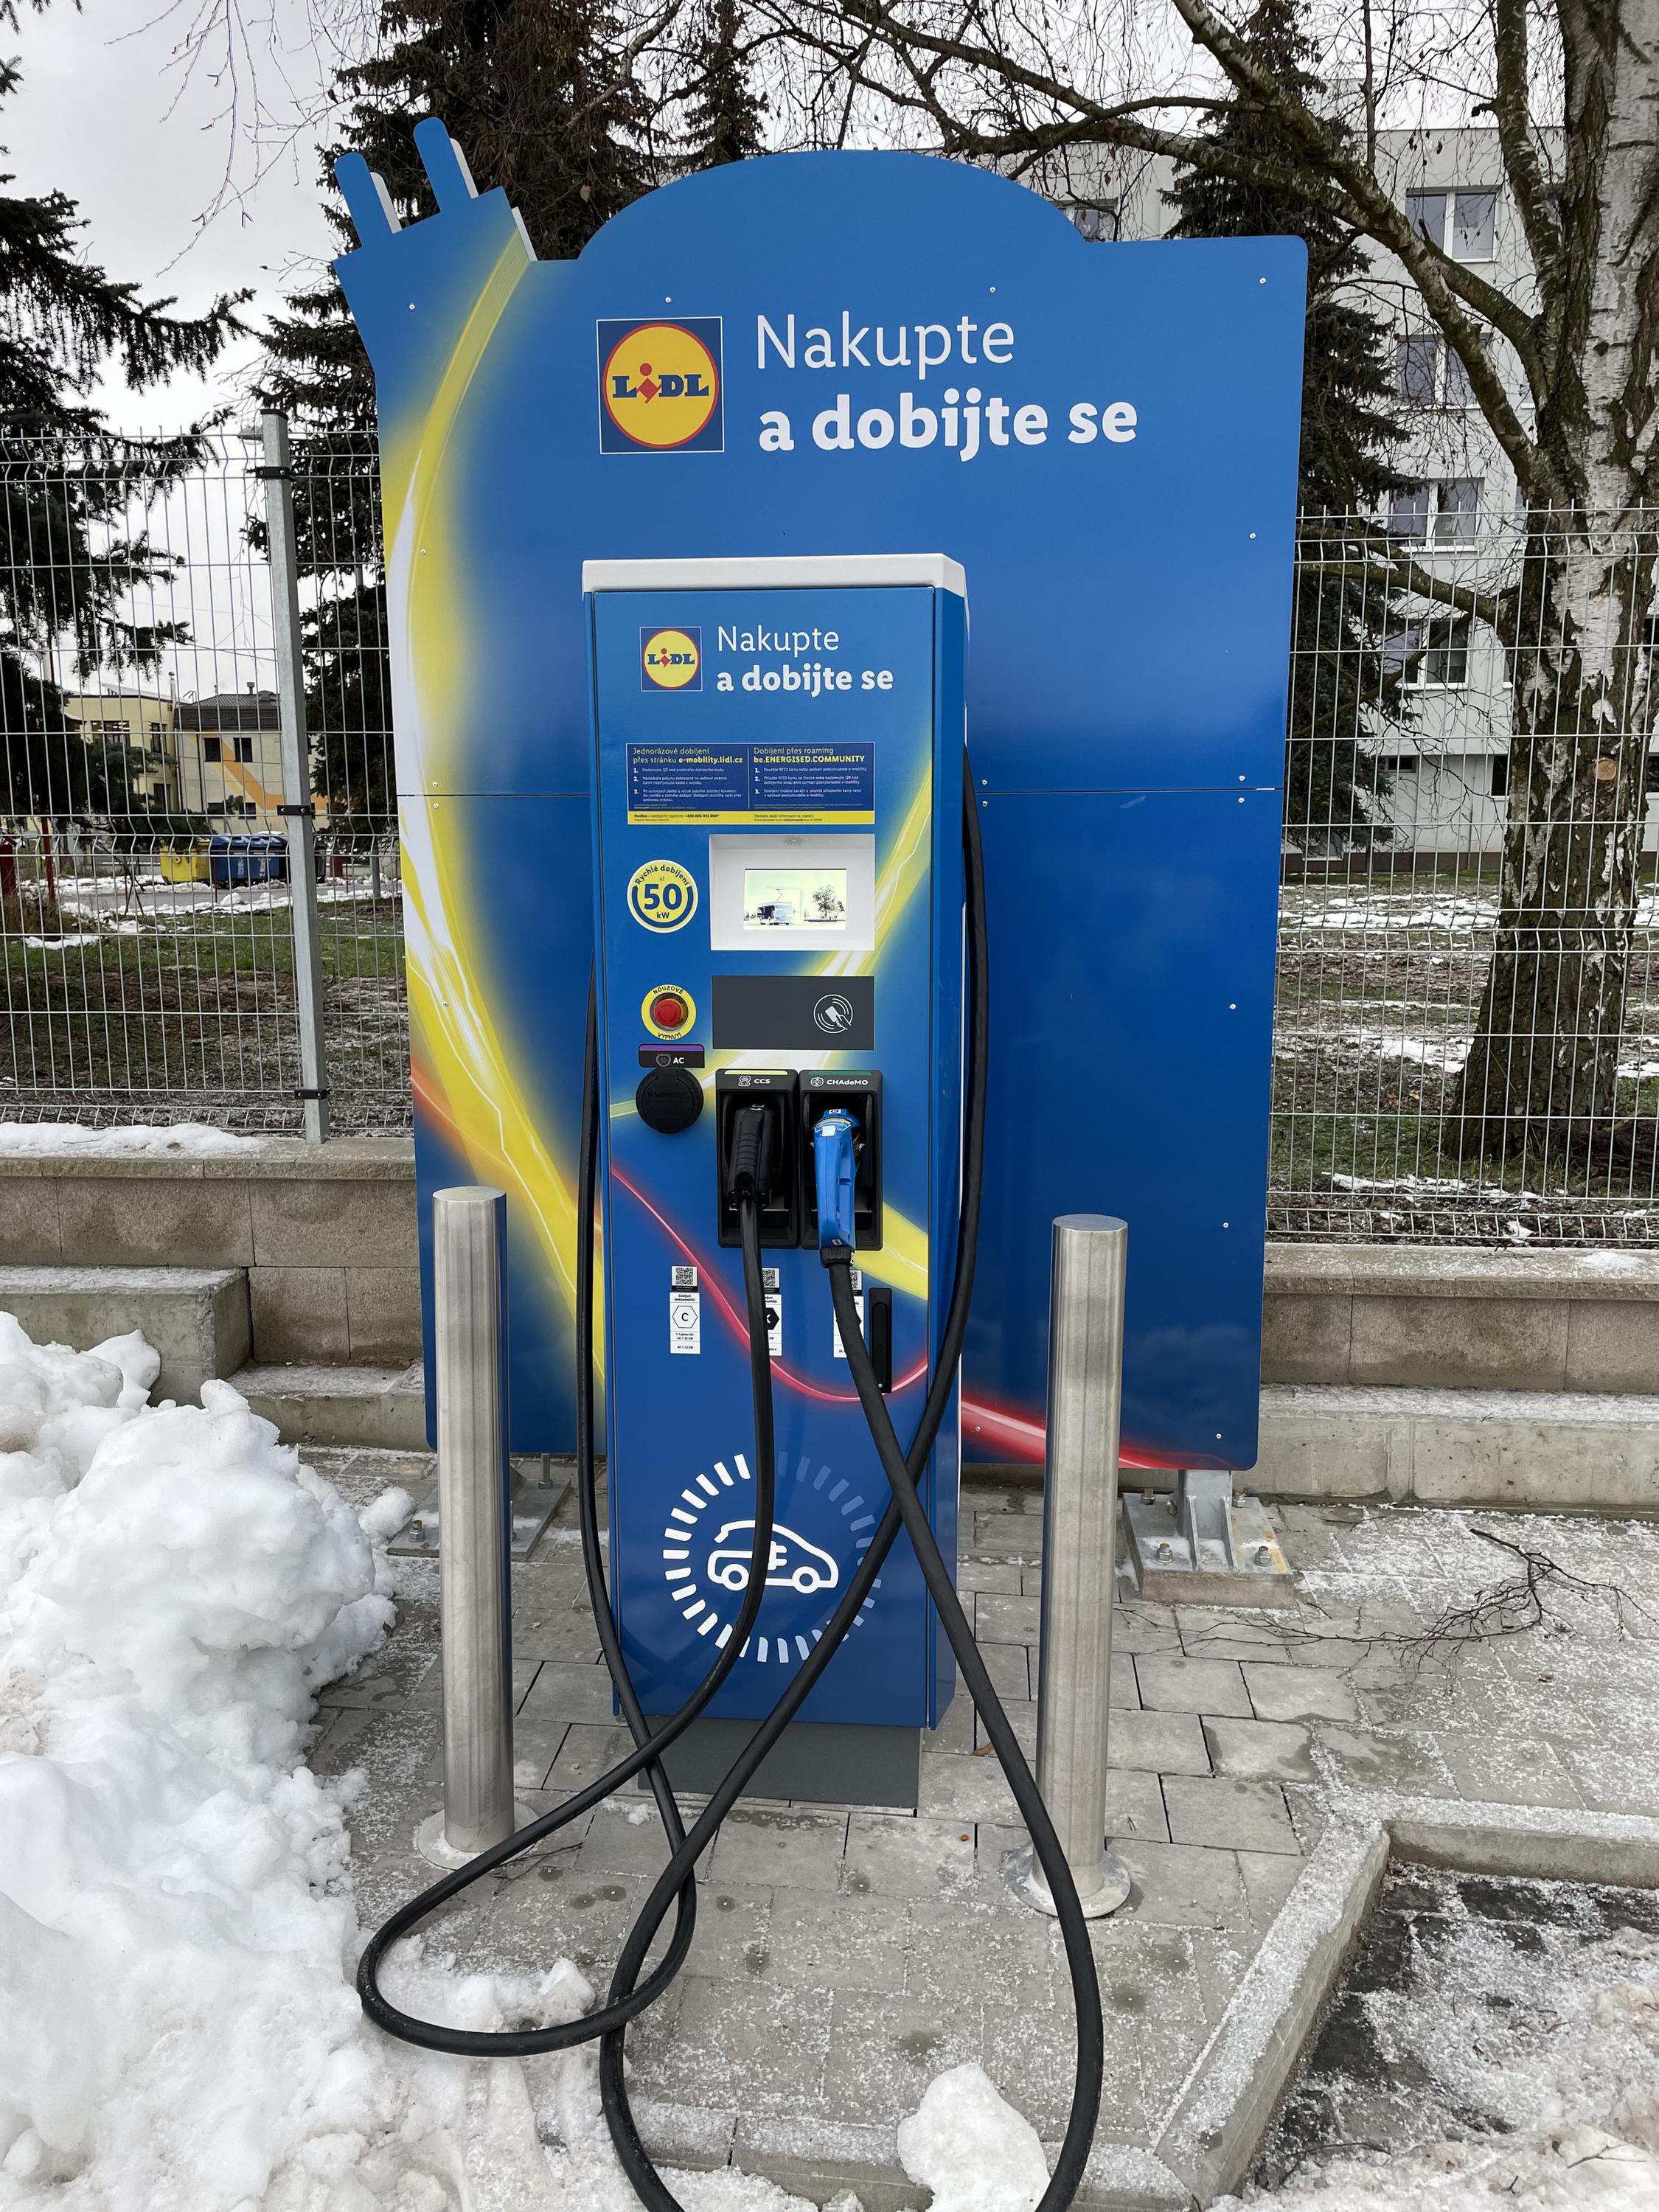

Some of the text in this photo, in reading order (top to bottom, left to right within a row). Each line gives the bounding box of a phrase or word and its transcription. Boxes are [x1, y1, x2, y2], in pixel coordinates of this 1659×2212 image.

[757, 310, 1015, 380] Nakupte
[758, 387, 1138, 462] a dobijte se
[717, 625, 840, 658] Nakupte
[717, 662, 894, 698] a dobijte se
[633, 757, 648, 765] přes
[678, 756, 743, 765] e-mobility.lidl.cz
[754, 755, 865, 763] be.ENERGISED.COMMUNITY
[787, 748, 802, 756] přes
[804, 748, 834, 756] roaming
[635, 865, 658, 885] Rychlé
[644, 883, 682, 910] 50
[681, 1312, 689, 1321] C
